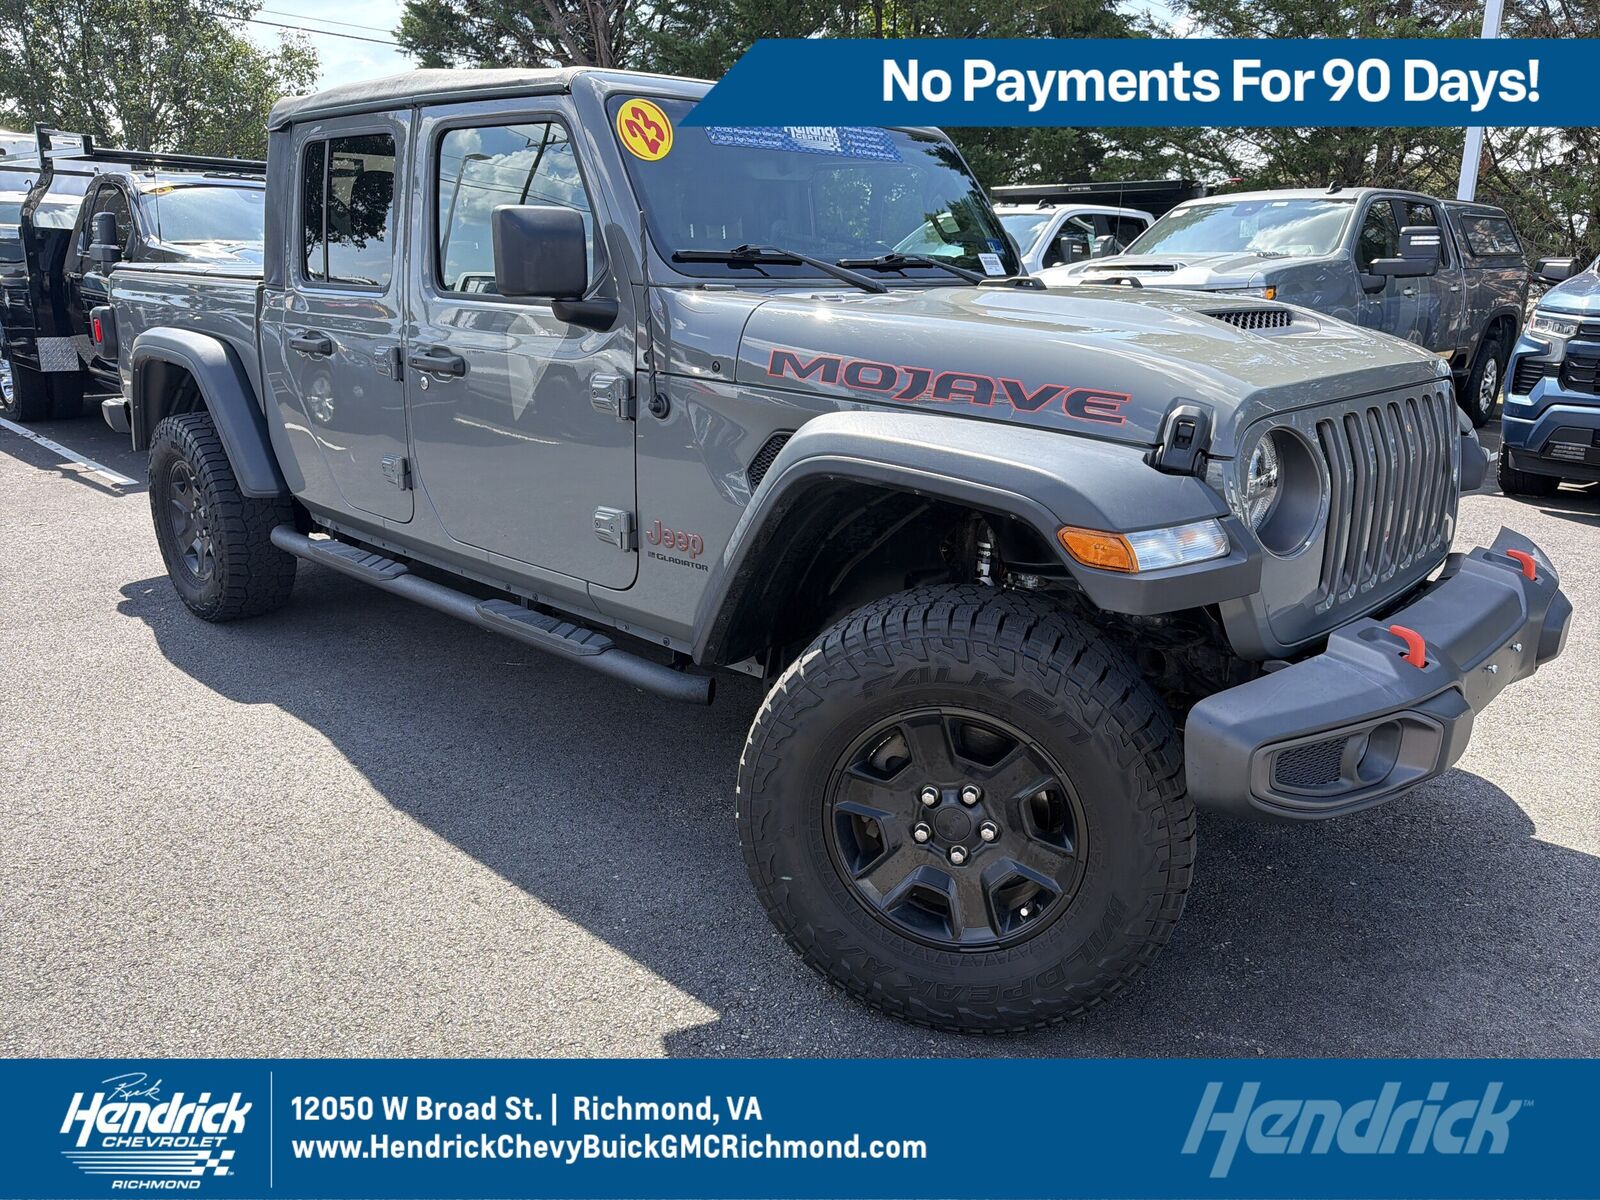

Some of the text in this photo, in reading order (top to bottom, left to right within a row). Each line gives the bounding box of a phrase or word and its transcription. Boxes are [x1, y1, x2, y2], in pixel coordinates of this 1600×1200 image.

[624, 106, 665, 155] 23
[766, 348, 1132, 426] MOJAVE
[645, 519, 704, 560] Jeep
[655, 553, 709, 572] GLADIATOR
